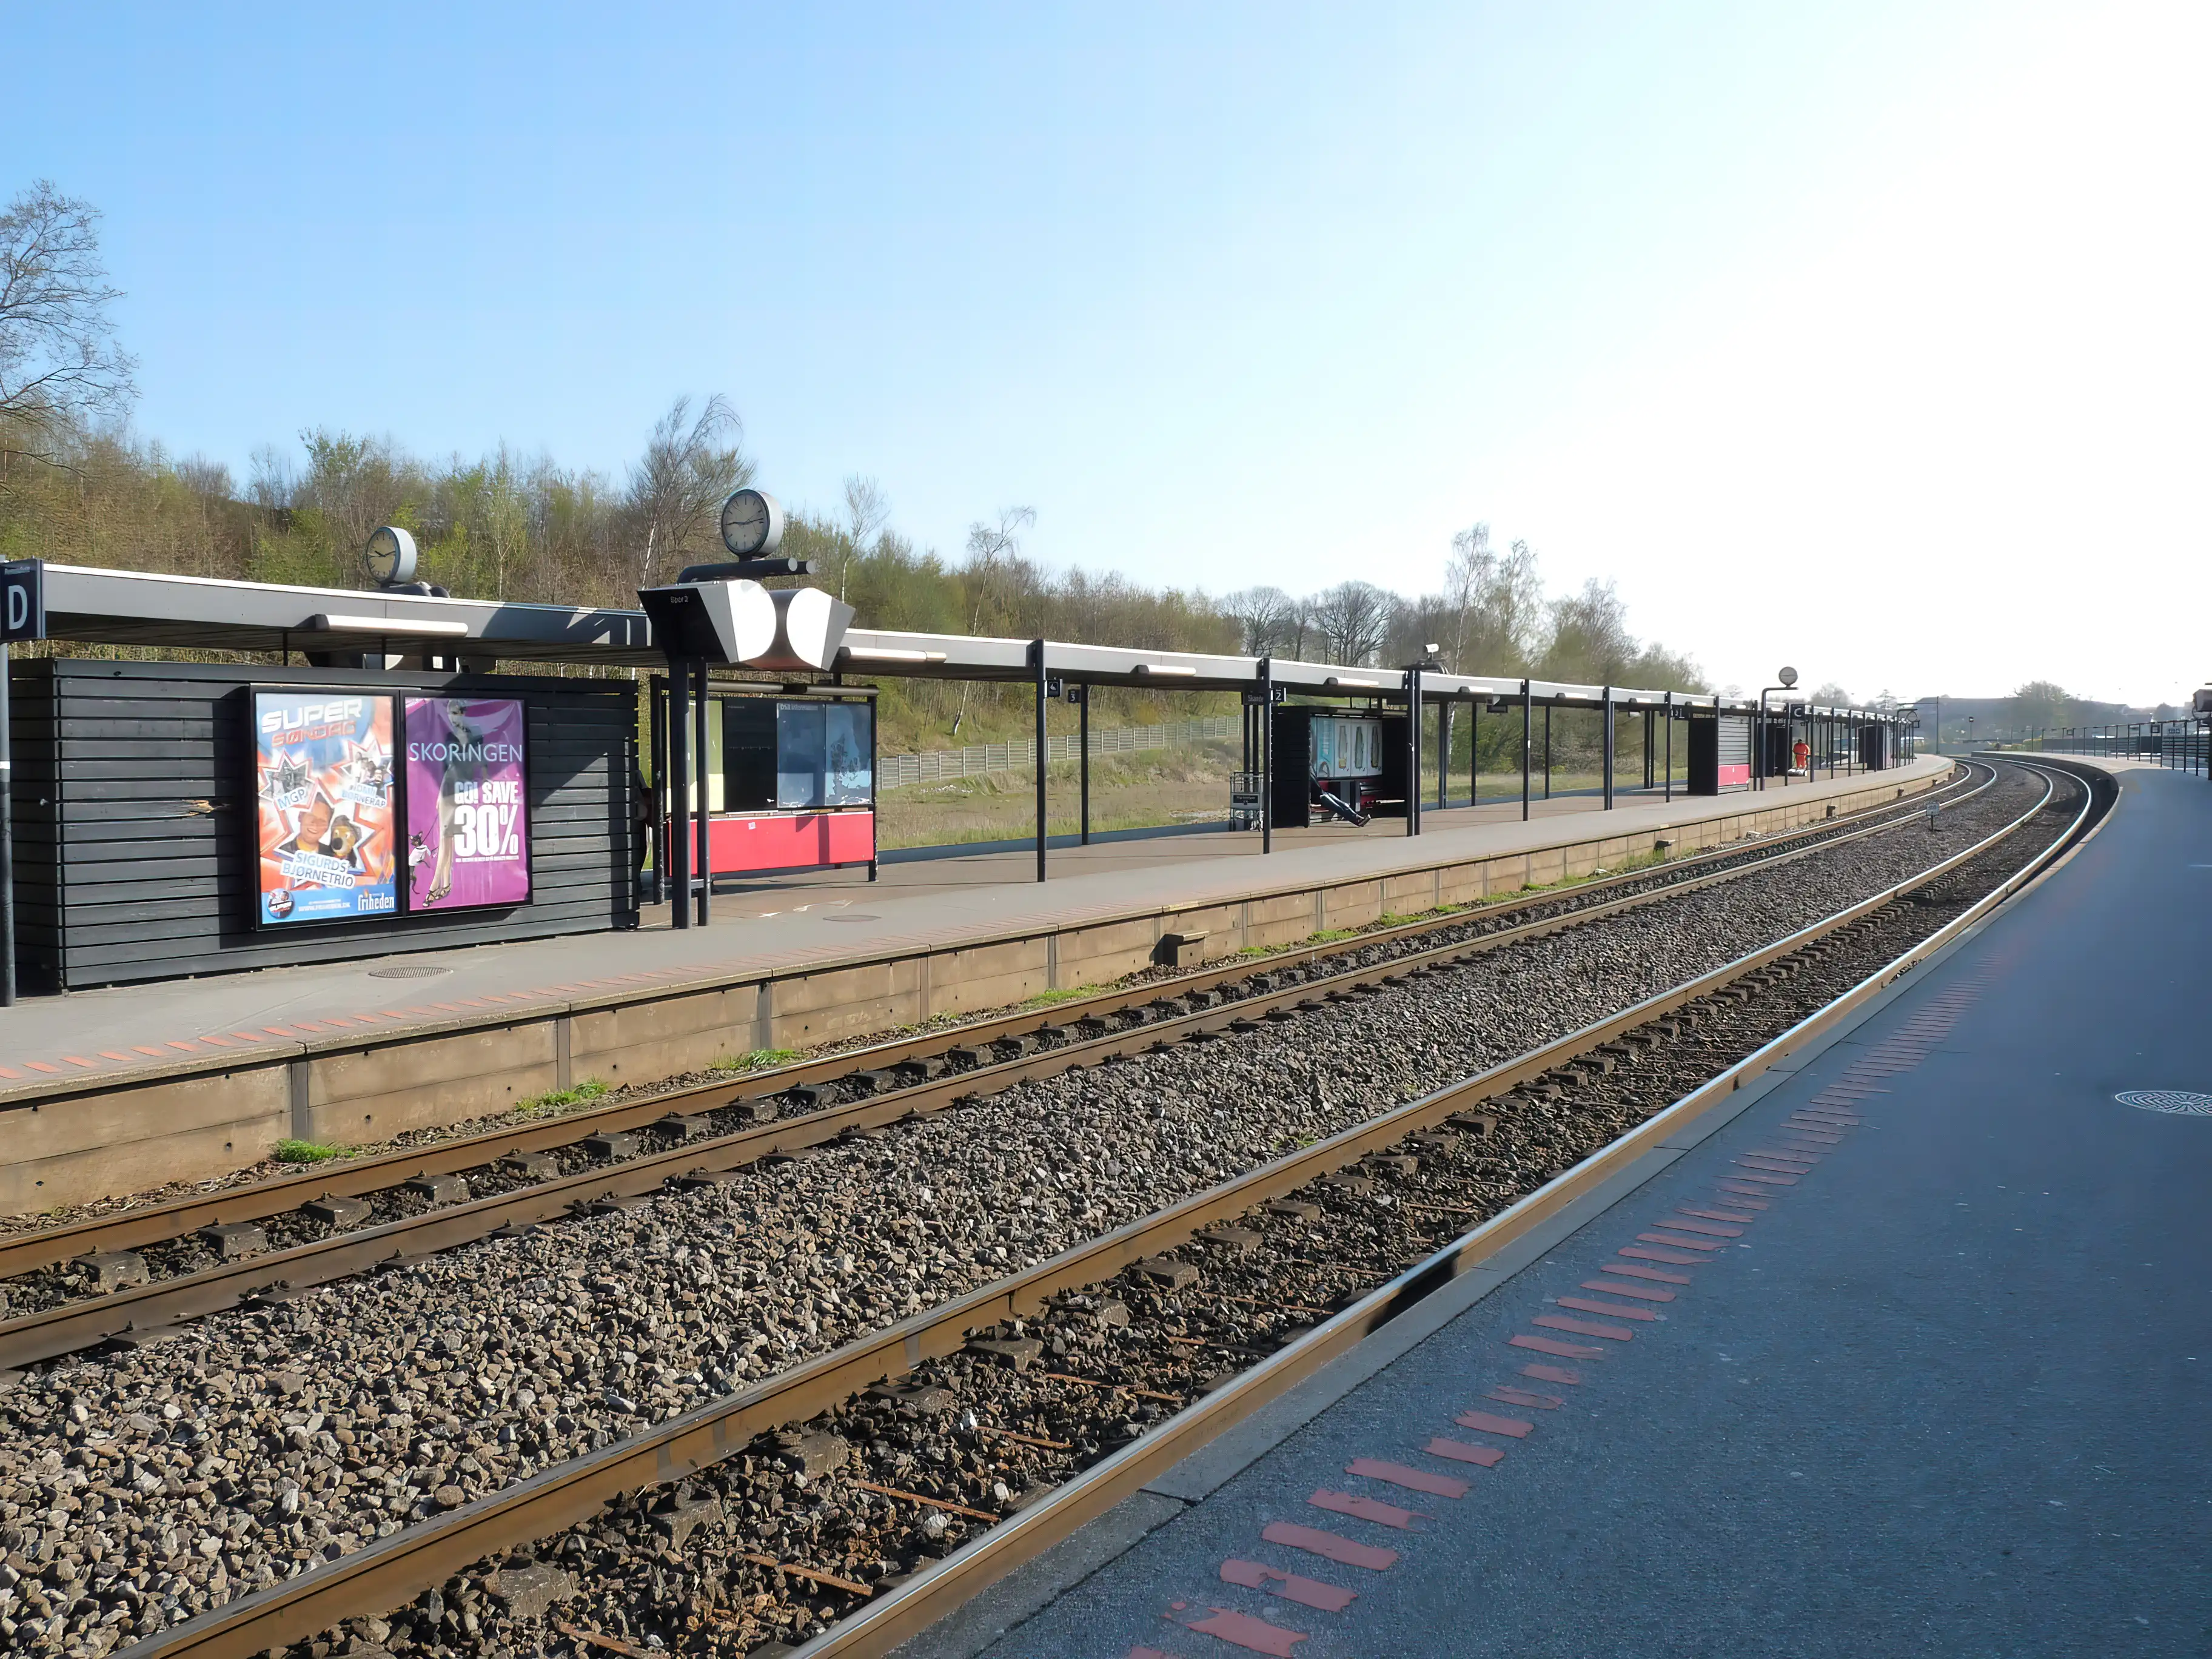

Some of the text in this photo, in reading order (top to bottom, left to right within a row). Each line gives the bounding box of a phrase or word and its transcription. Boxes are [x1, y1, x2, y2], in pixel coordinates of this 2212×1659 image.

[8, 585, 28, 629] D
[1070, 693, 1076, 702] 3
[1275, 692, 1282, 700] 2
[262, 699, 362, 734] SUPER
[1794, 708, 1802, 717] C
[409, 742, 523, 762] SKORINGEN
[277, 788, 307, 809] MGP
[454, 780, 518, 804] GO! SAVE
[454, 804, 519, 857] 30%
[295, 852, 347, 872] SIGURDS
[283, 863, 354, 887] BJØRNETRIO
[358, 891, 395, 911] friheden
